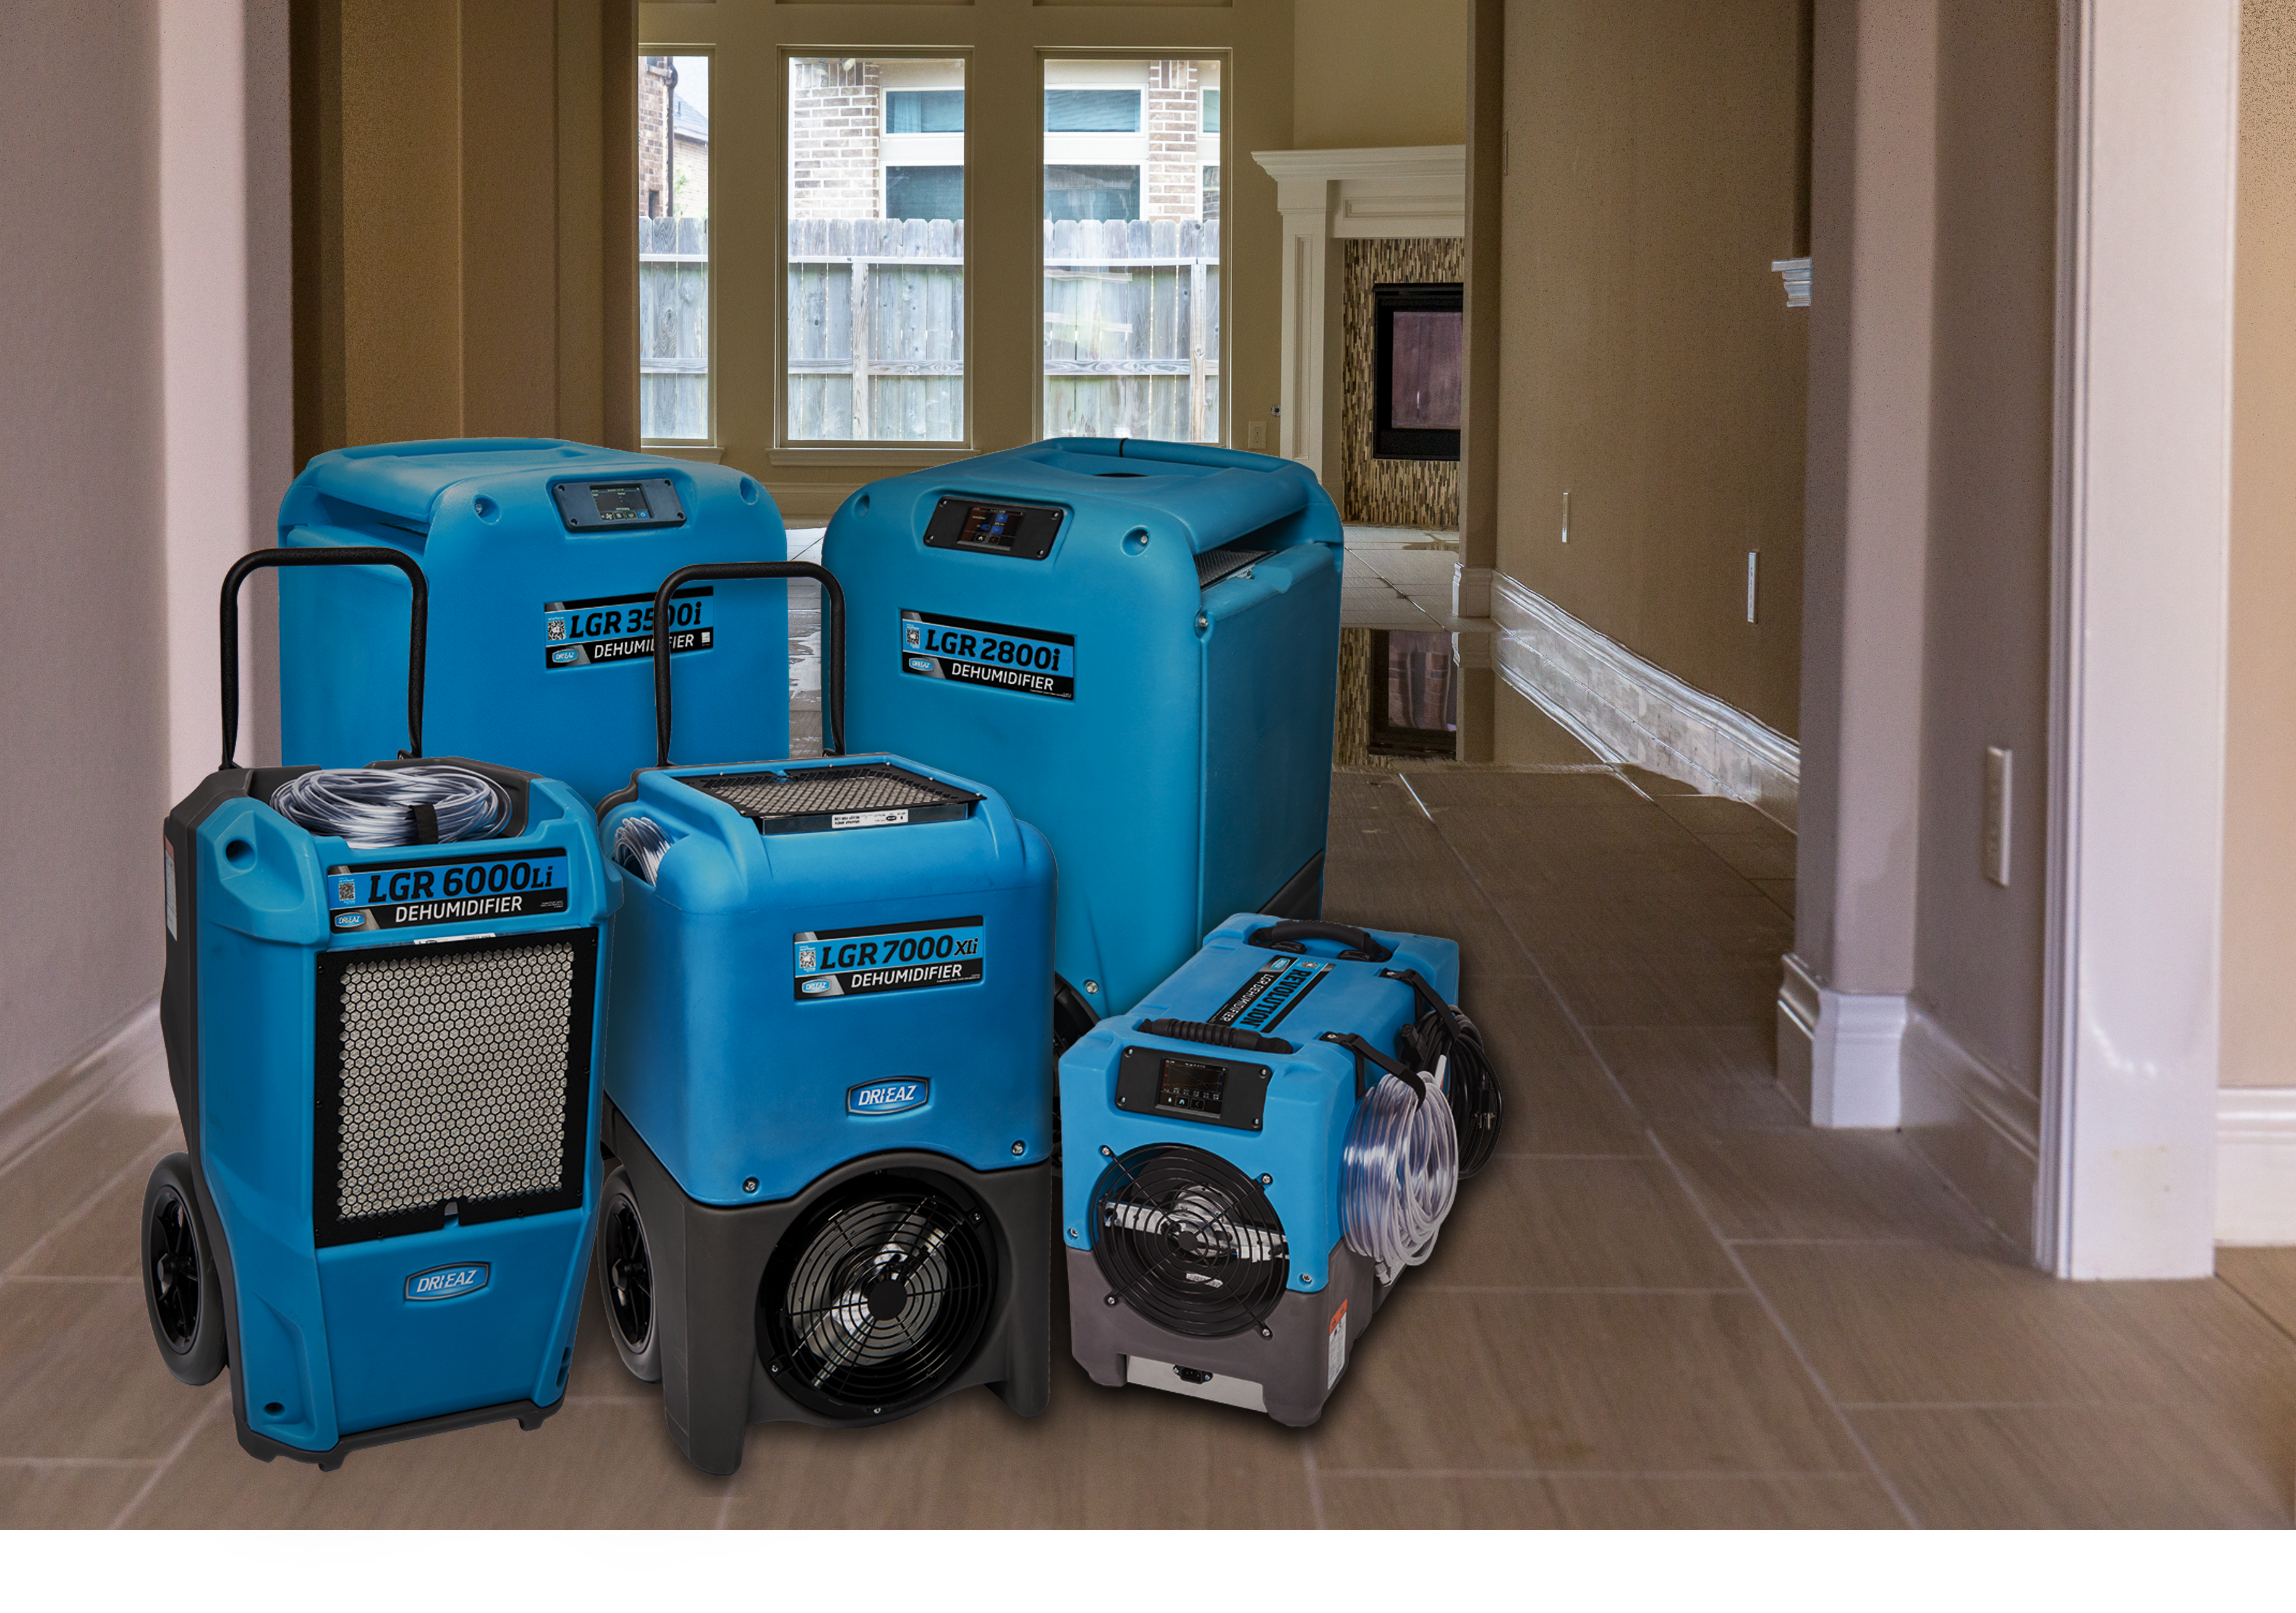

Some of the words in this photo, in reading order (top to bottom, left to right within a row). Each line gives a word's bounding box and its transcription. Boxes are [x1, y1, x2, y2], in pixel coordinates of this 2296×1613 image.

[569, 611, 621, 639] LGR
[594, 634, 694, 658] DEHUMIIER
[925, 629, 976, 657] LGR
[980, 638, 1060, 671] 2800i
[952, 663, 1054, 691] DEHUMIDIFIER
[368, 870, 433, 903] LGR
[395, 896, 522, 922] DEHUMIDIFIER
[820, 942, 878, 969] LGR
[851, 964, 962, 988] DEHUMIDIFIER
